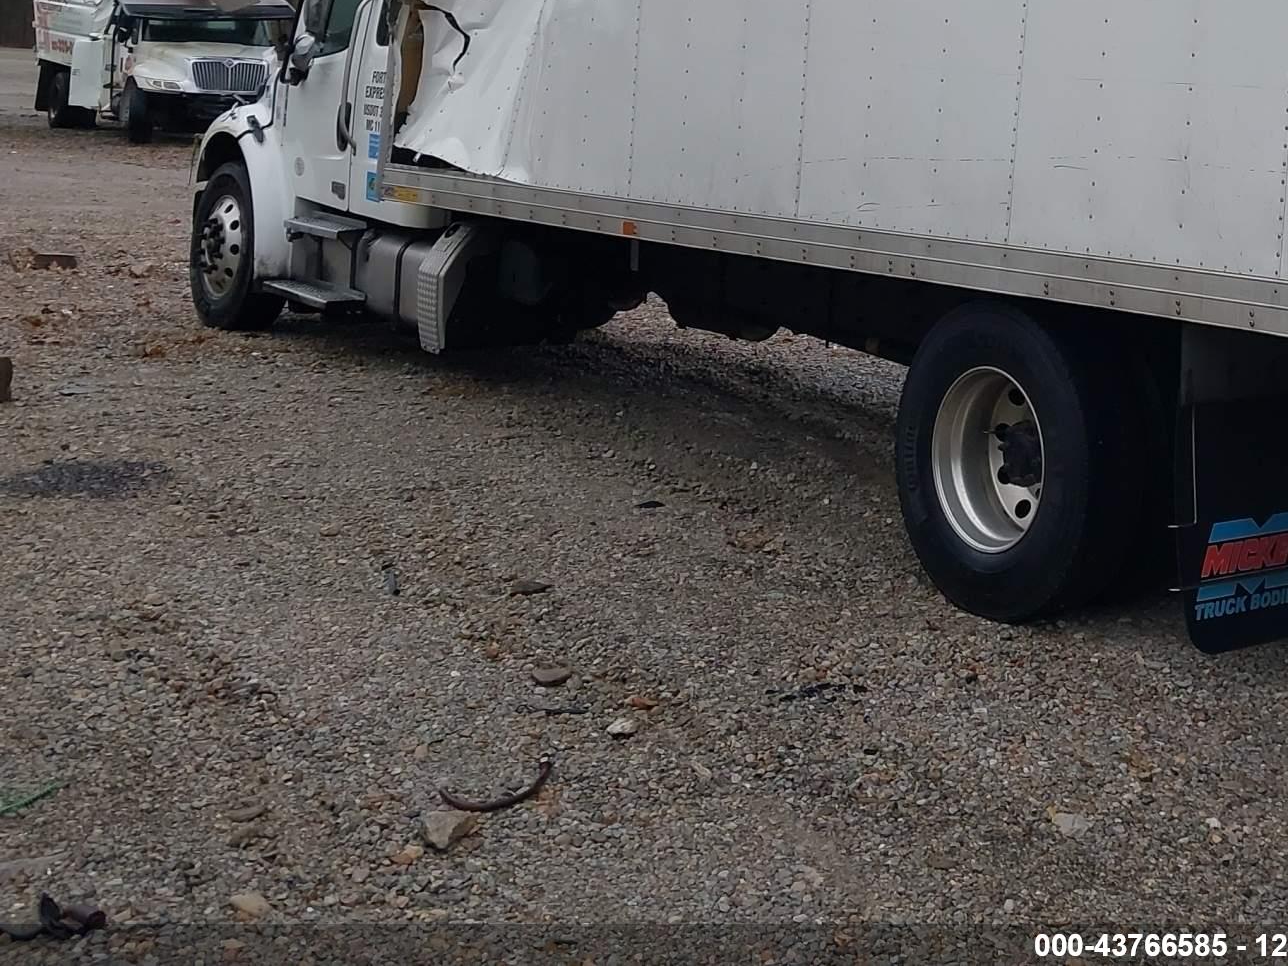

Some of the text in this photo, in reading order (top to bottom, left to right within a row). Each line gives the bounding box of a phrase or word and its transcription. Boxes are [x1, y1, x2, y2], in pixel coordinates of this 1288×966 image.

[363, 103, 379, 117] USDOT
[366, 119, 374, 131] MC
[1194, 595, 1248, 621] TRUCK
